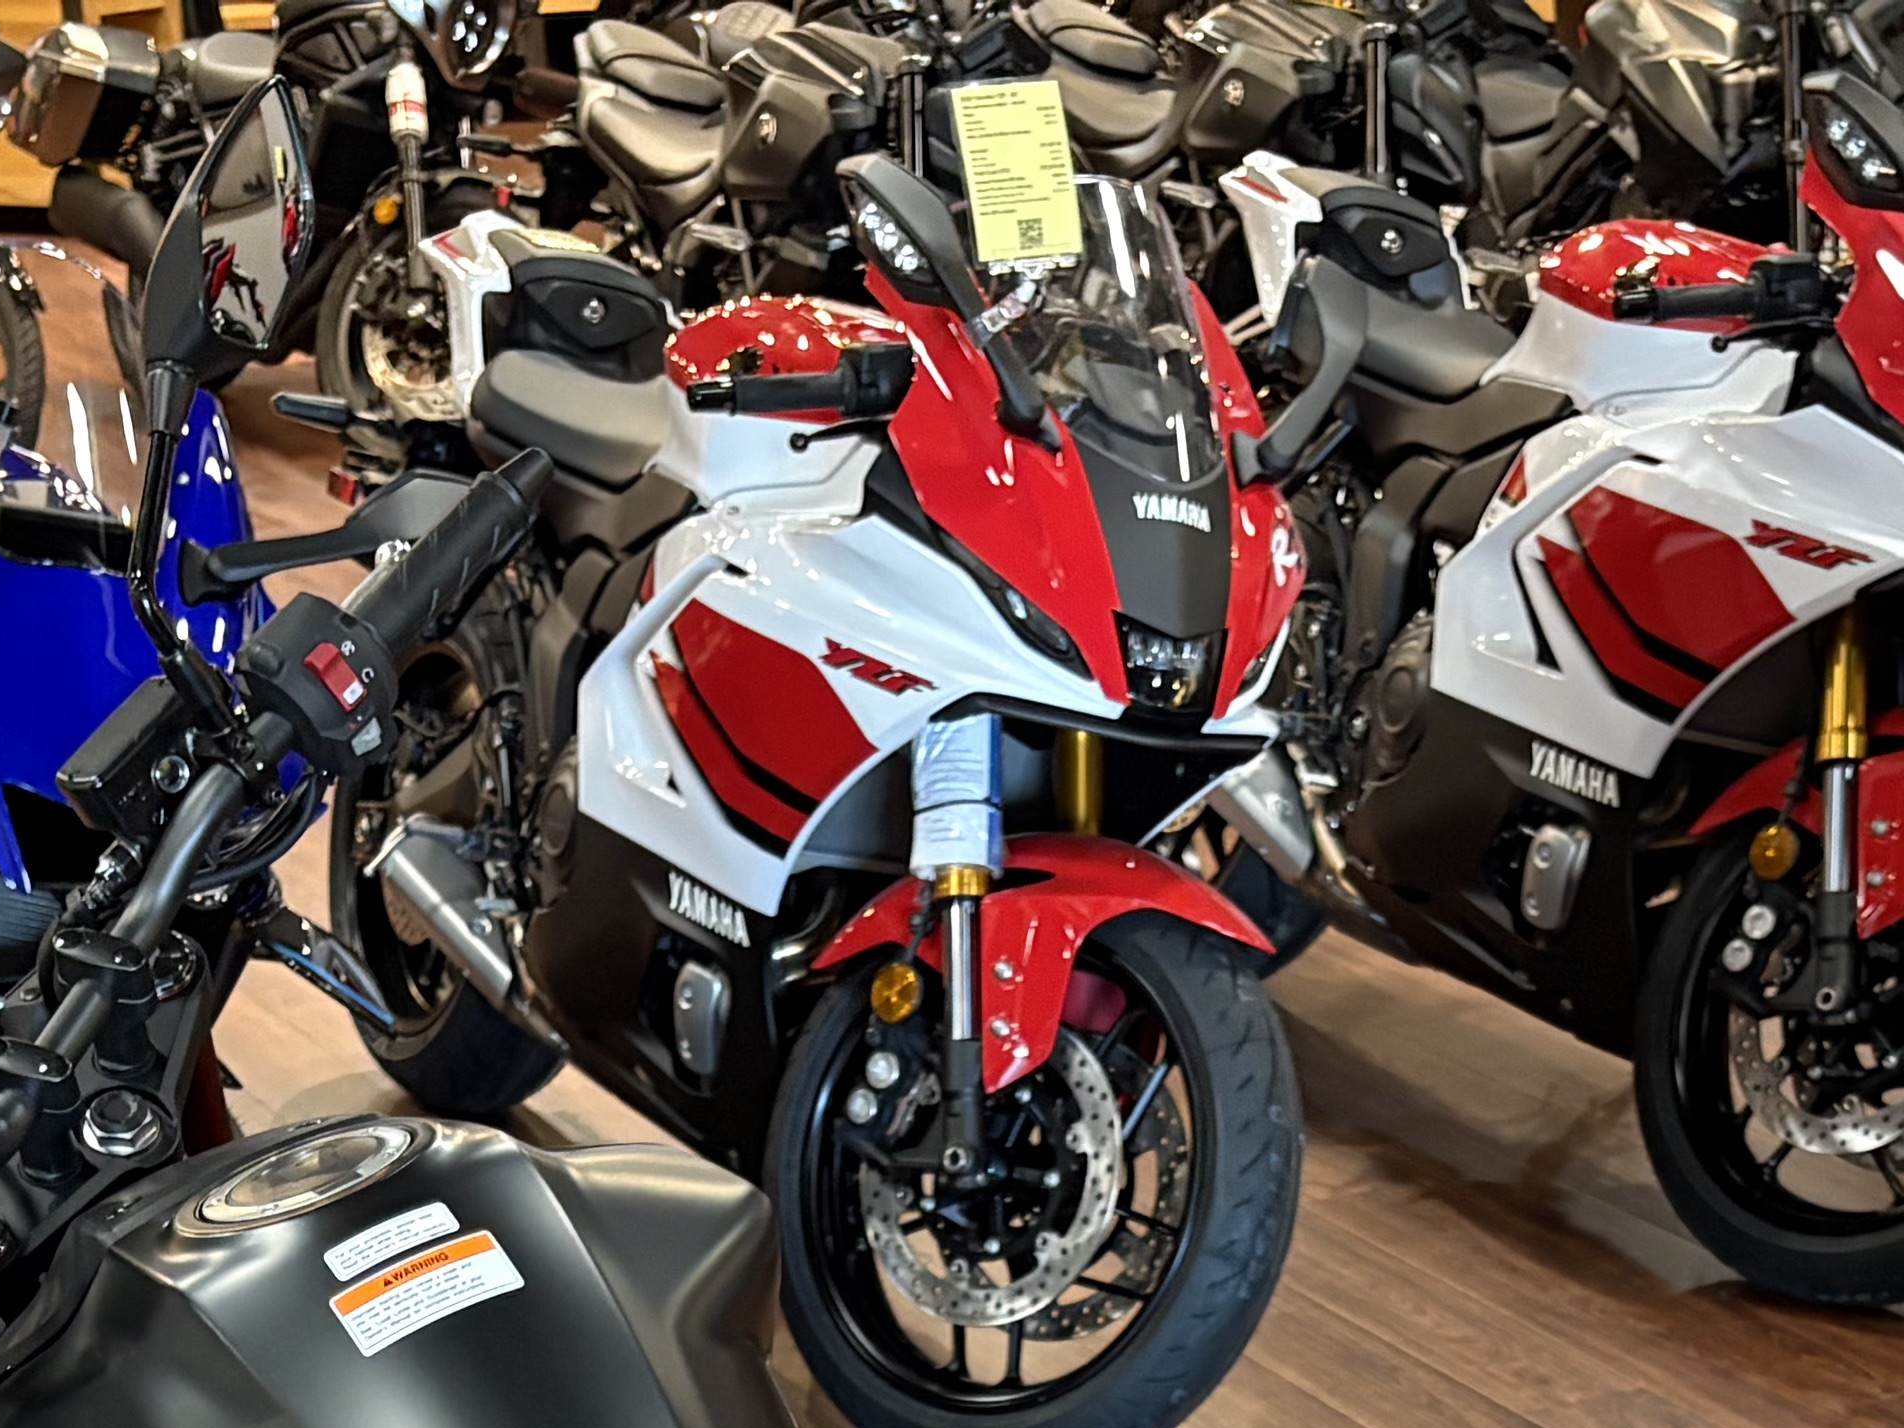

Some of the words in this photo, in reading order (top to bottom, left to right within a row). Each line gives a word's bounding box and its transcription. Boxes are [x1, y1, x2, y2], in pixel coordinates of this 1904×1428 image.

[1132, 492, 1211, 533] YAMAHA
[1529, 740, 1621, 808] YAMAHA
[668, 871, 751, 948] YAMAHA
